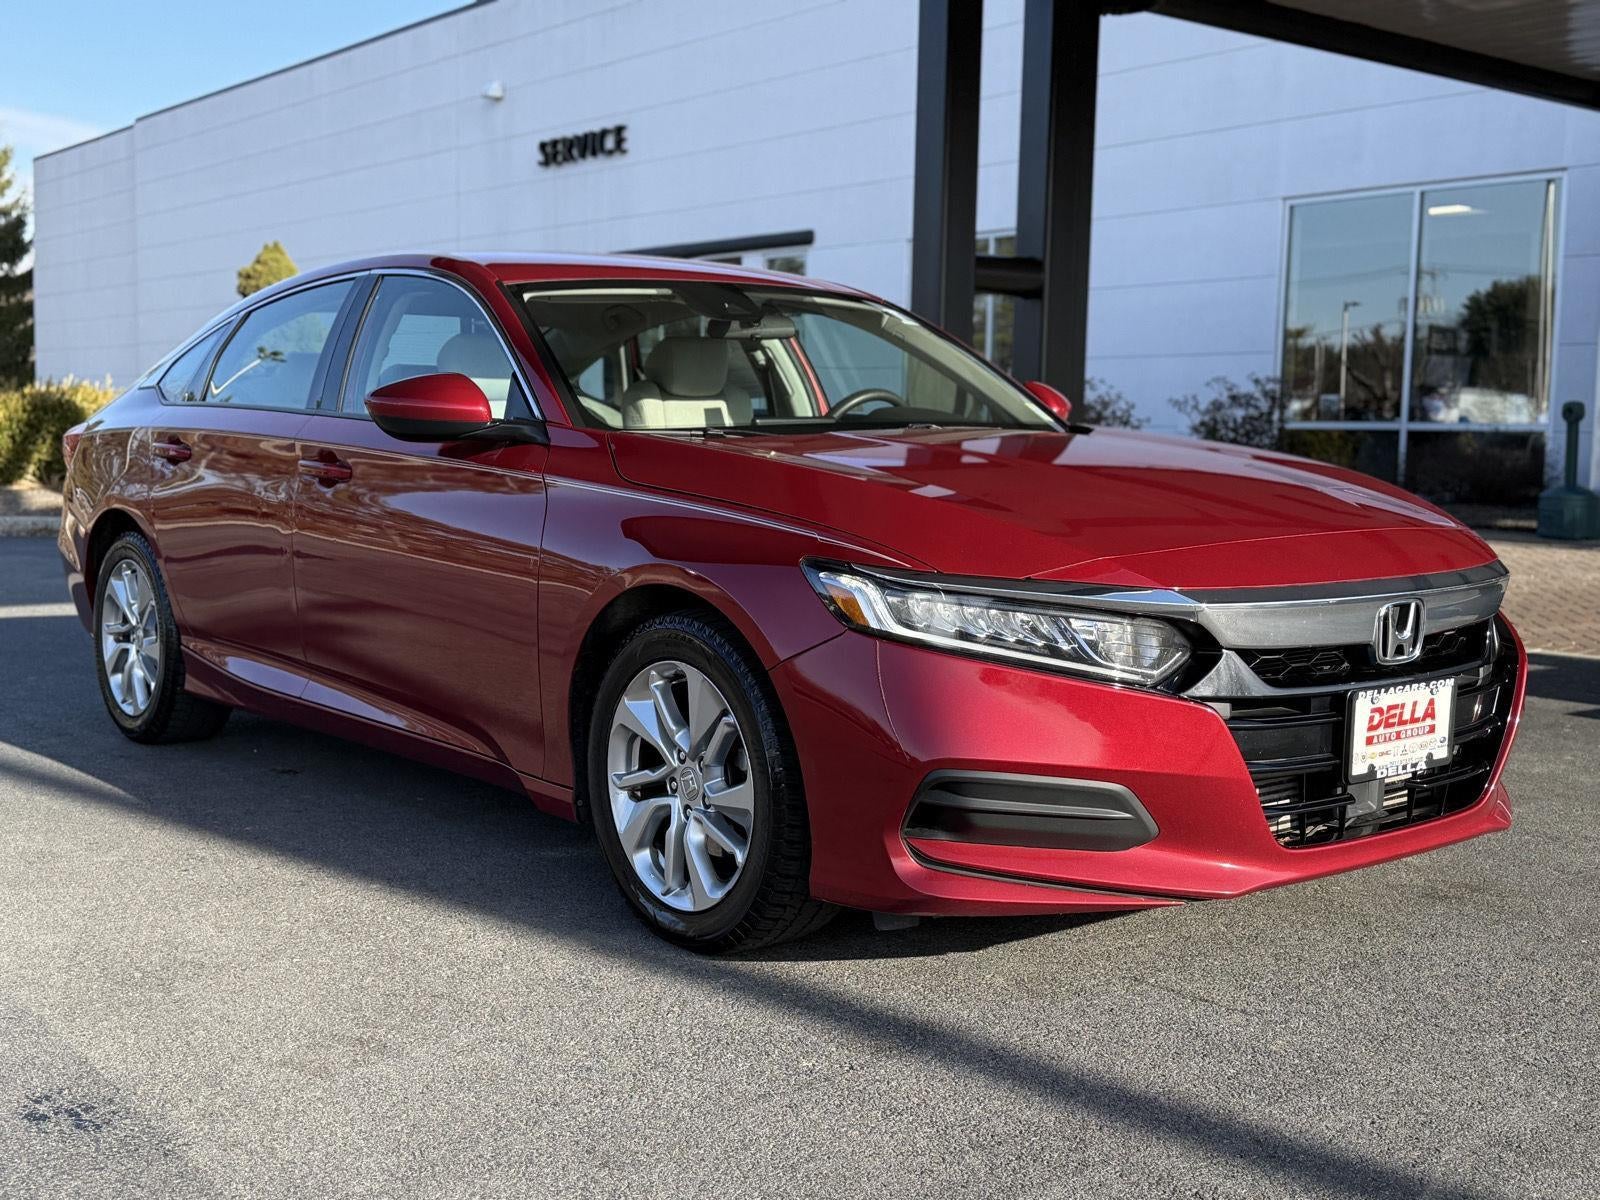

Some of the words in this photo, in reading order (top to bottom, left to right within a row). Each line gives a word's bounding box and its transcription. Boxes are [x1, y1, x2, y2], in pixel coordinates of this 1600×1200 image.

[538, 125, 627, 167] SERVICE
[1358, 678, 1455, 700] DELLACARS.COM
[1366, 698, 1436, 732] DELLA
[1373, 732, 1397, 743] AUTO
[1400, 726, 1430, 739] GROUP
[1376, 761, 1427, 779] DELLA
